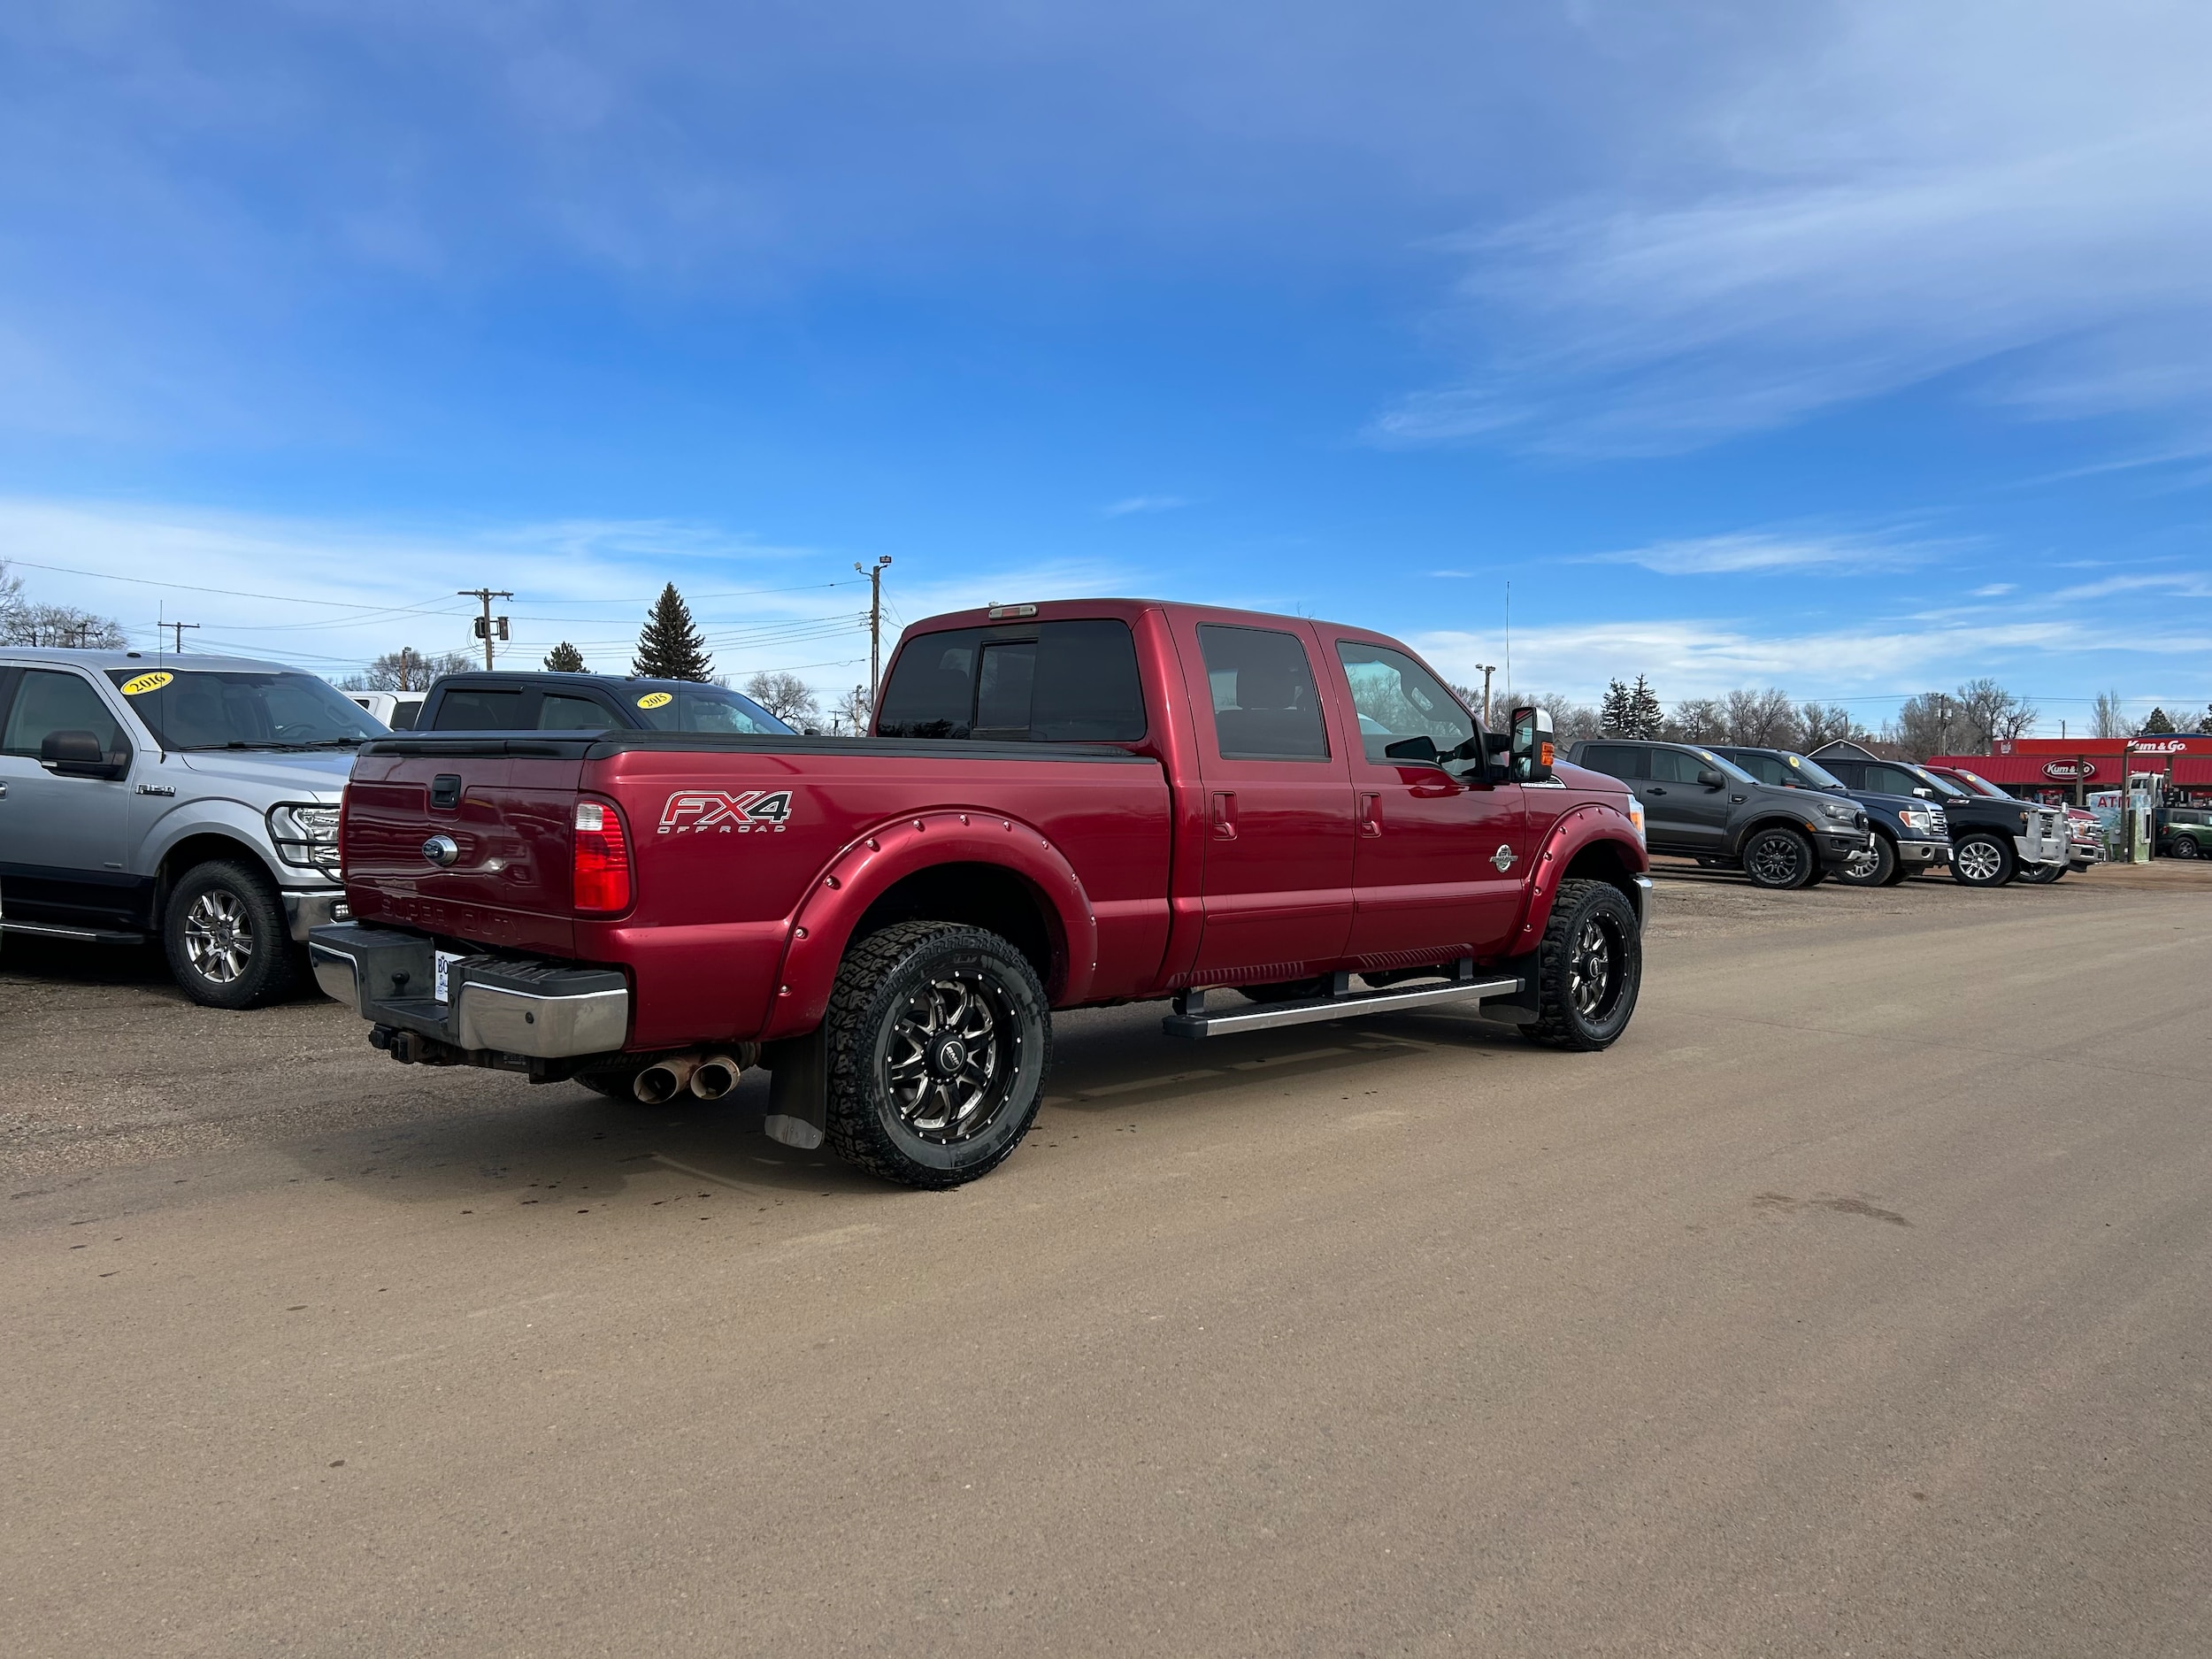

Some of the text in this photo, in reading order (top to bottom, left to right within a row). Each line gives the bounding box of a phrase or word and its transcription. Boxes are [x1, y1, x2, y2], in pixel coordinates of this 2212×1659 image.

[130, 674, 165, 692] 2016
[643, 694, 668, 707] 2015
[2126, 740, 2186, 752] Kum & Go
[2047, 764, 2069, 774] Kum
[659, 790, 793, 825] FX4
[657, 825, 787, 834] OFF ROAD
[381, 896, 523, 941] SUPER DUTY
[438, 958, 450, 974] BO
